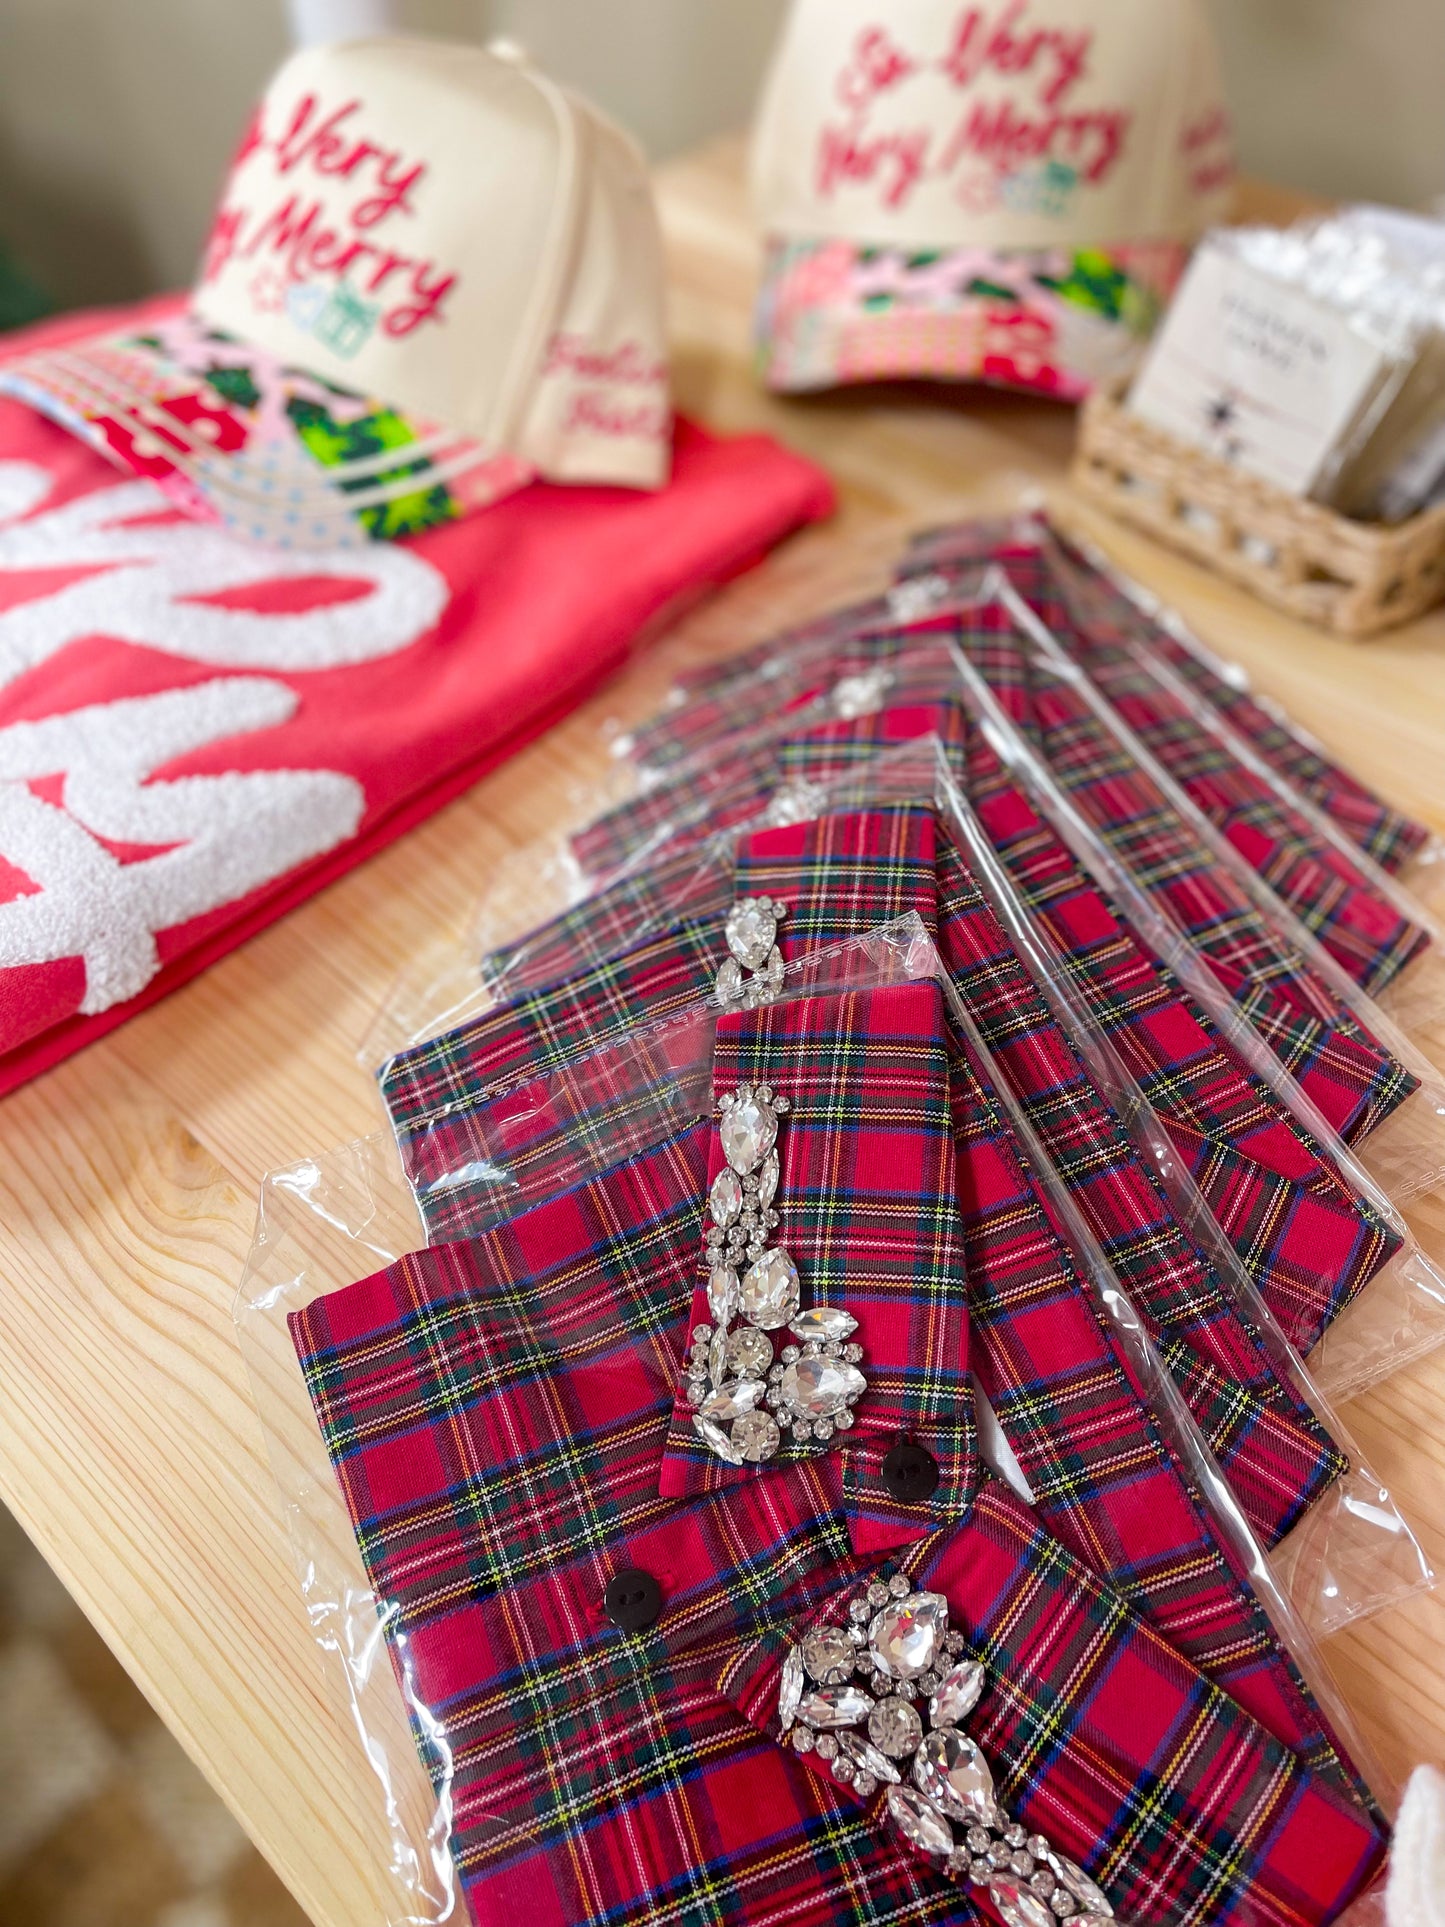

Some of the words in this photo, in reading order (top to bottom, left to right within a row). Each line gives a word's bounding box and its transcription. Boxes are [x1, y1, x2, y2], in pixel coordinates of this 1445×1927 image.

[940, 0, 1093, 106] Very
[276, 92, 428, 232] Very
[941, 98, 1131, 190] Merry
[243, 196, 460, 342] Merry
